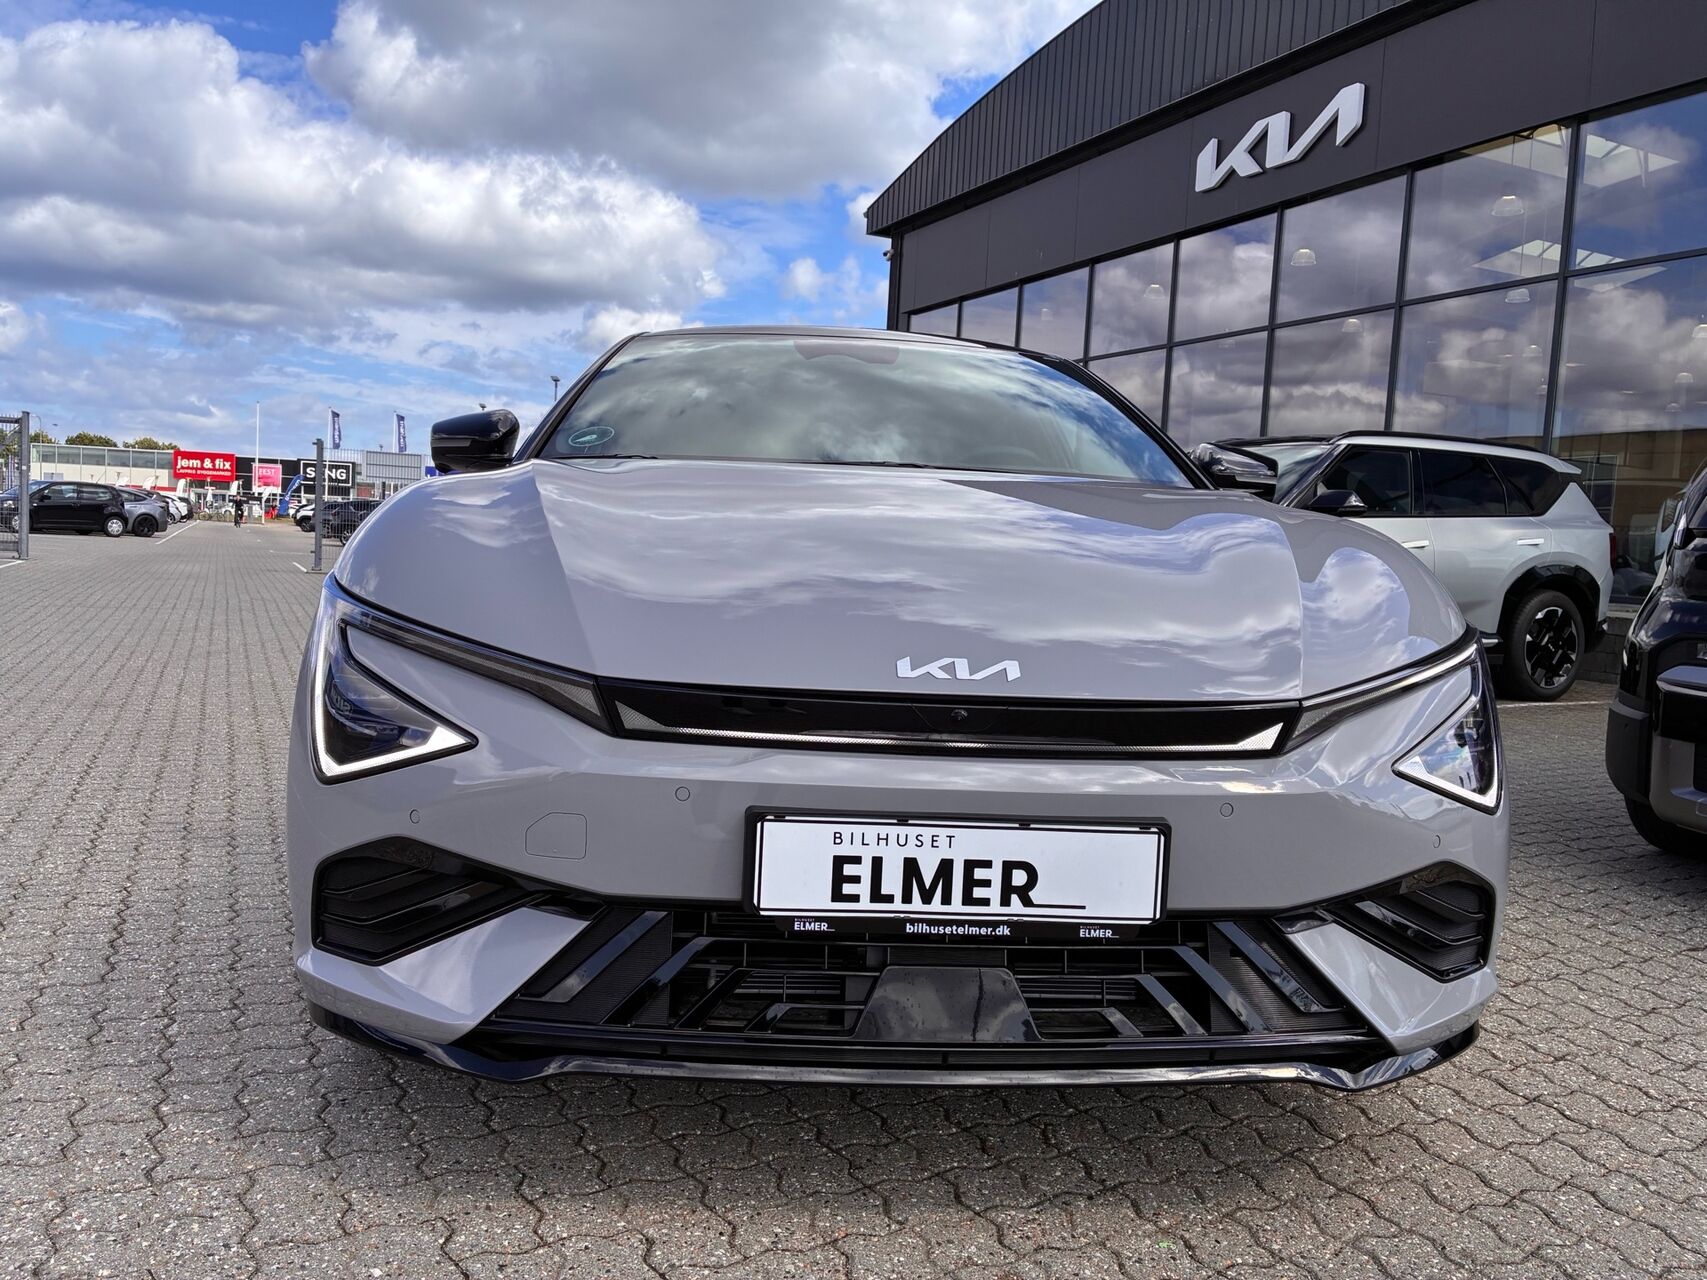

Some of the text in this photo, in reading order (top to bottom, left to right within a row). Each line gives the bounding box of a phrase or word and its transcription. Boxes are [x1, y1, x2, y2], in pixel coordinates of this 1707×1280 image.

[1195, 82, 1366, 192] KIA
[176, 455, 232, 470] jem & fix
[306, 467, 347, 480] SNG
[896, 656, 1021, 682] KIA
[833, 831, 956, 849] BILHUSET
[830, 854, 1086, 910] ELMER
[794, 921, 835, 931] ELMER
[905, 922, 1011, 936] bilhusetelmer.dk
[1080, 929, 1120, 938] ELMER
